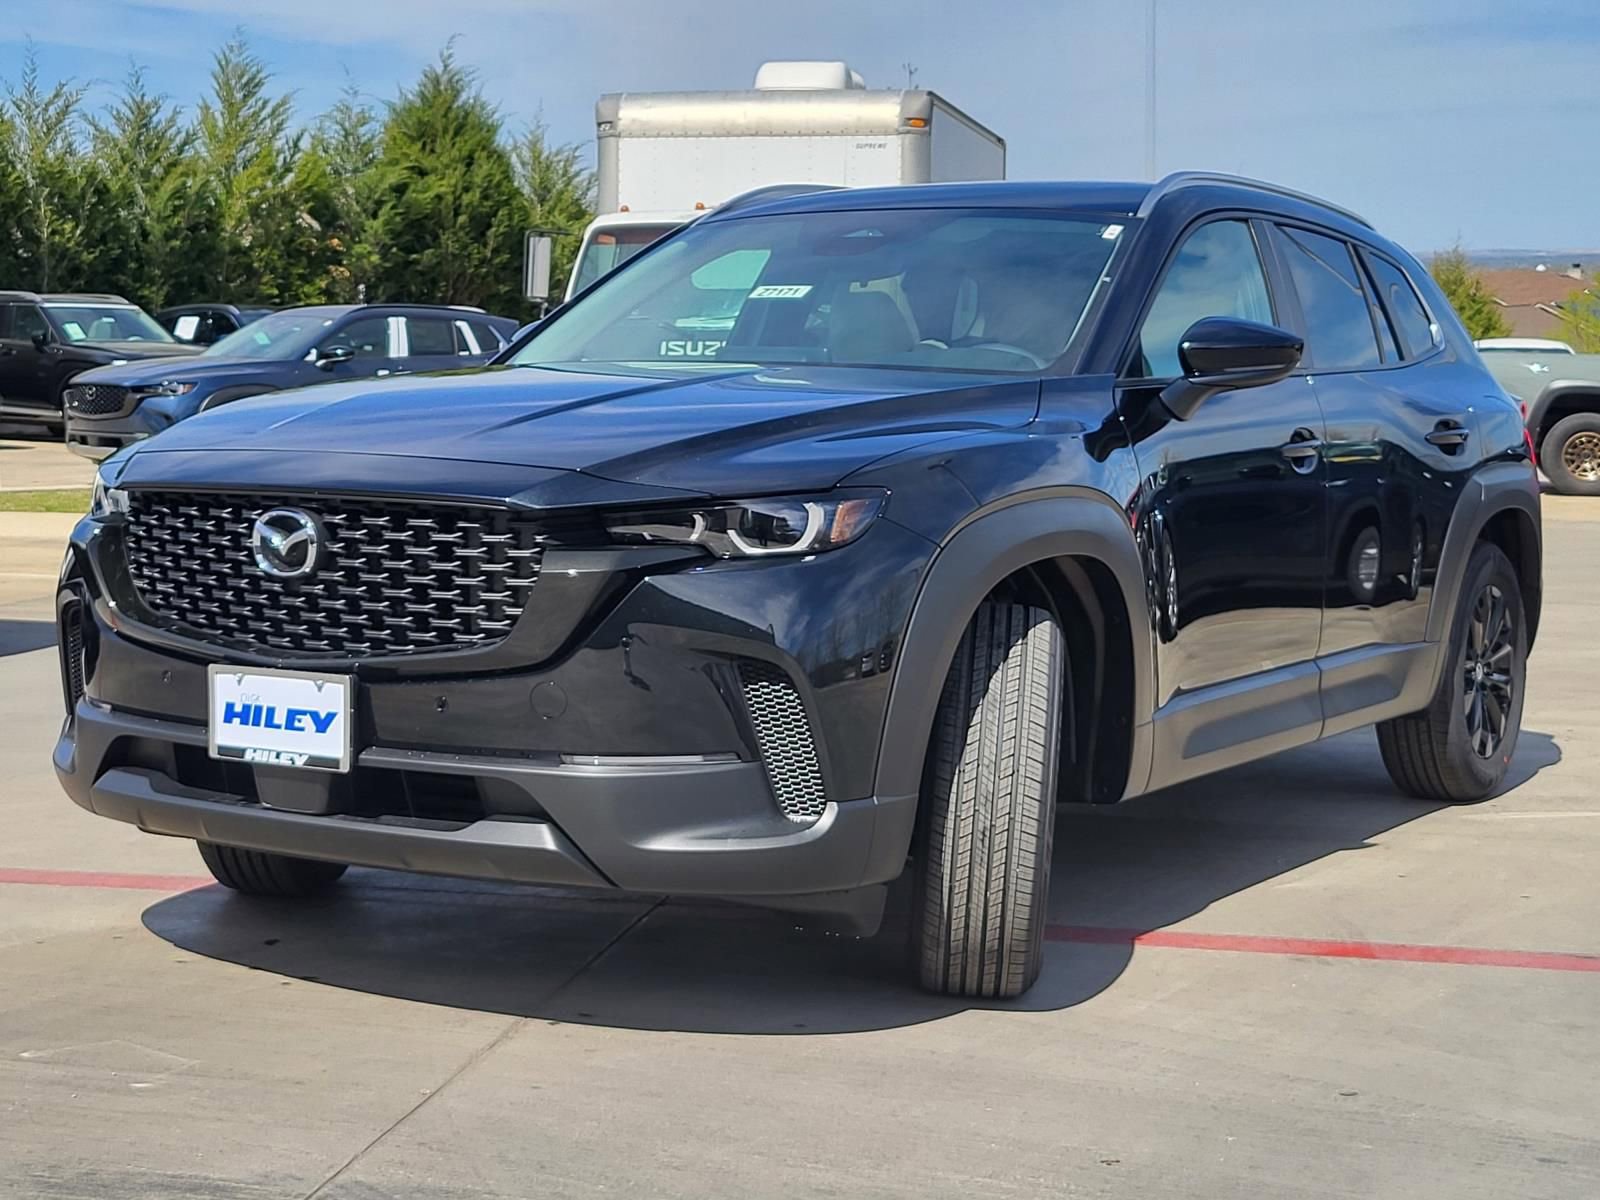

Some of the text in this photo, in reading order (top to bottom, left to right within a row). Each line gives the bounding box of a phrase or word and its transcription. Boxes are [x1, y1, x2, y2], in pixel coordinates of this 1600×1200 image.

[660, 341, 727, 356] ISUZ
[223, 701, 338, 734] HILEY
[243, 748, 309, 767] HILEY
